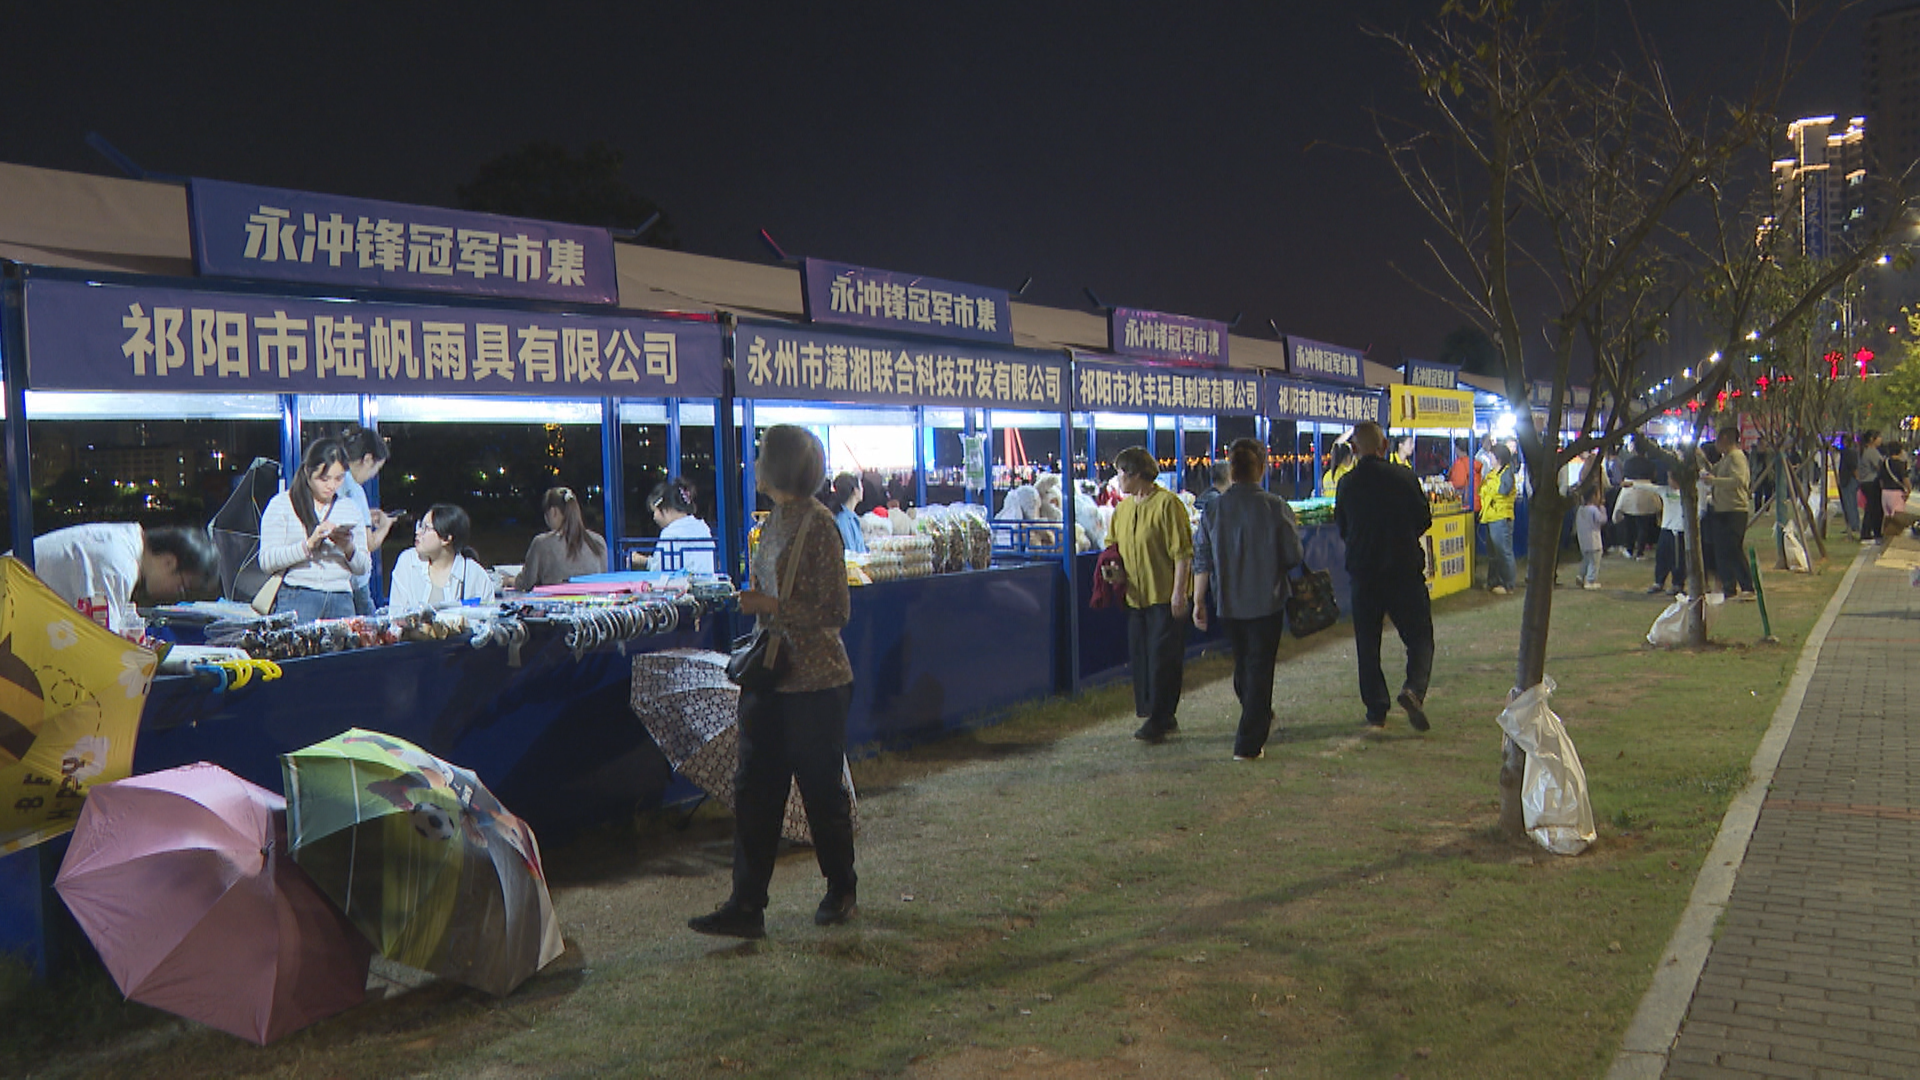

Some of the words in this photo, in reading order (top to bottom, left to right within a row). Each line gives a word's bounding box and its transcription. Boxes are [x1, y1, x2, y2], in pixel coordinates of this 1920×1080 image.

[244, 205, 587, 287] 永冲锋冠军市集
[830, 274, 998, 332] 永冲锋冠军市集
[121, 302, 678, 386] 祁阳市陆帆雨具有限公司
[1124, 318, 1220, 356] 永冲锋冠军市集
[1295, 345, 1358, 377] 永冲锋冠军市集
[747, 336, 1062, 404] 永州市潇湘联合科技开发有限公司
[1079, 367, 1258, 410] 祁阳市兆丰玩具制造有限公司
[1278, 385, 1379, 421] 祁阳市鑫旺米业有限公司
